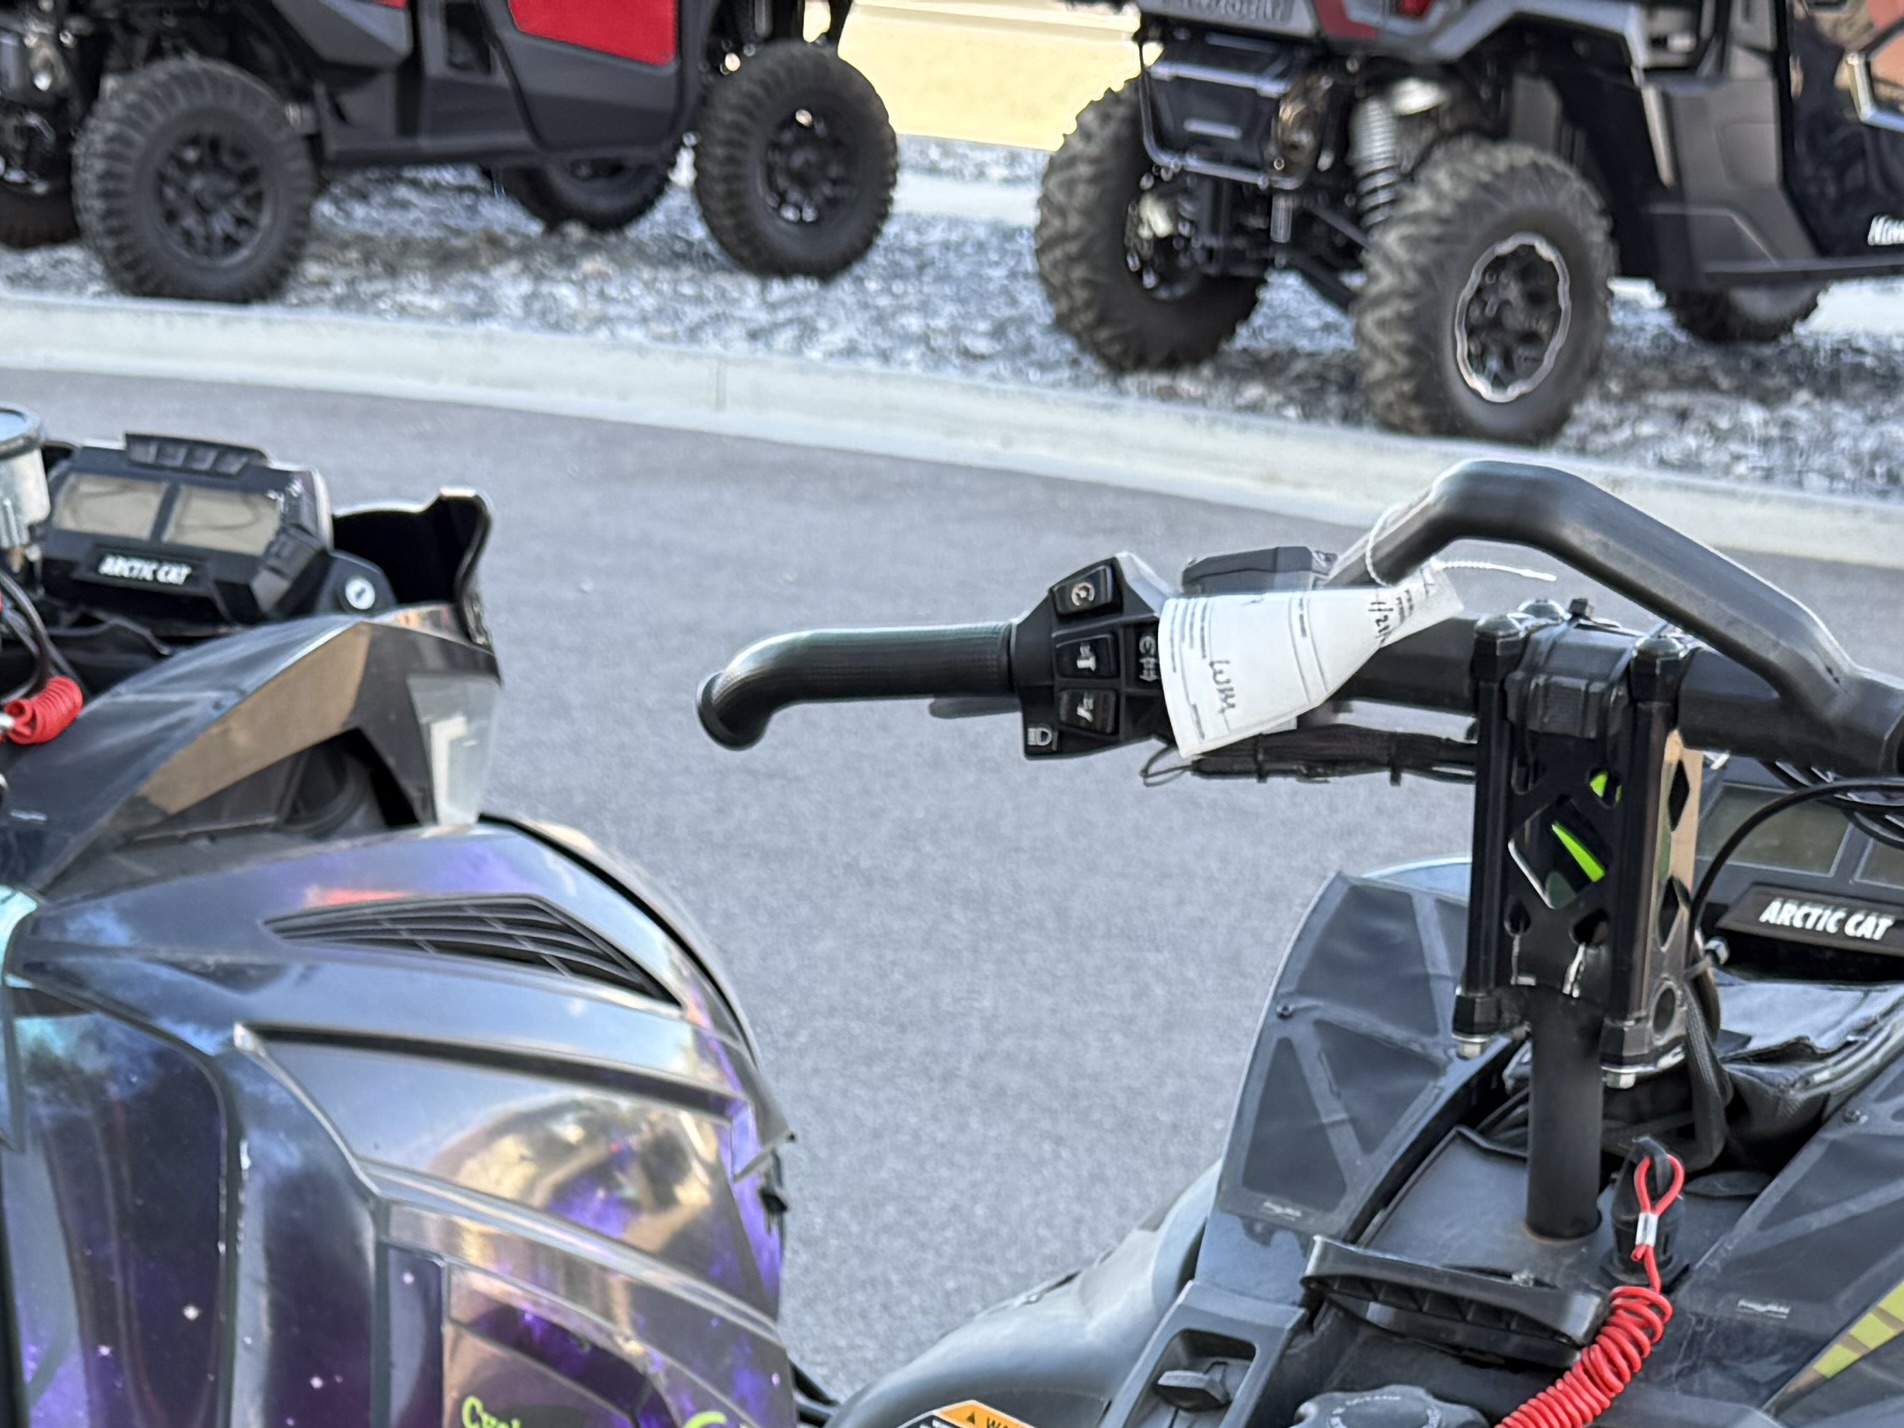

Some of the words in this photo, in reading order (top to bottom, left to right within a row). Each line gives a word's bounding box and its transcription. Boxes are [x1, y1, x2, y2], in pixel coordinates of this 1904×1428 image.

[99, 554, 155, 581] ARCTIC
[160, 562, 192, 586] CAT
[1760, 896, 1840, 935] ARCTIC
[1841, 908, 1894, 941] CAT
